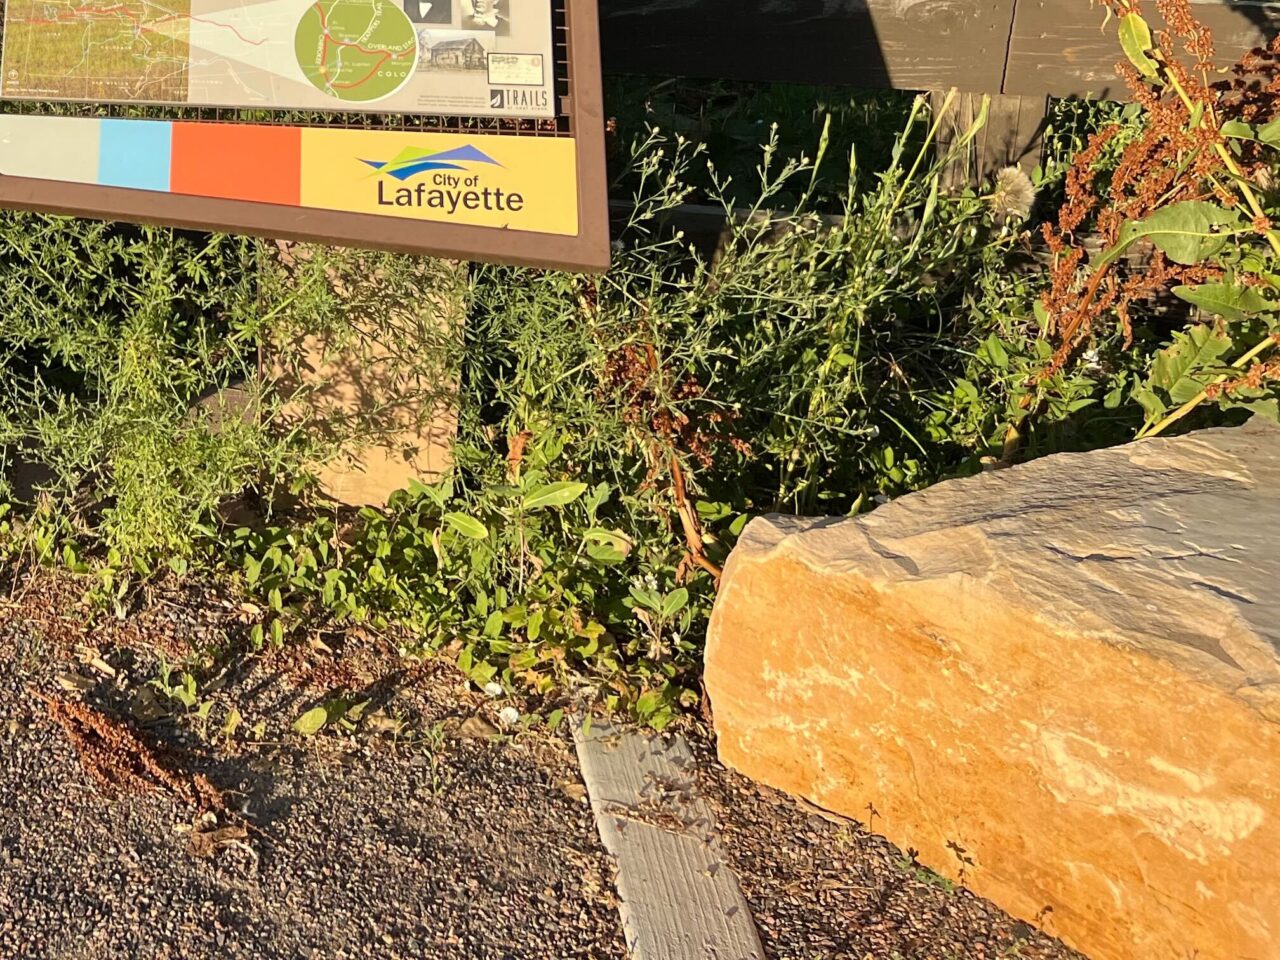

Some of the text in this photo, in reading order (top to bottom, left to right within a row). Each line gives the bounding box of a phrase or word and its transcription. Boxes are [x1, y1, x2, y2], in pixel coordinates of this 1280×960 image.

[506, 89, 548, 107] TRAILS
[432, 173, 479, 189] City of
[378, 180, 524, 215] Lafayette
